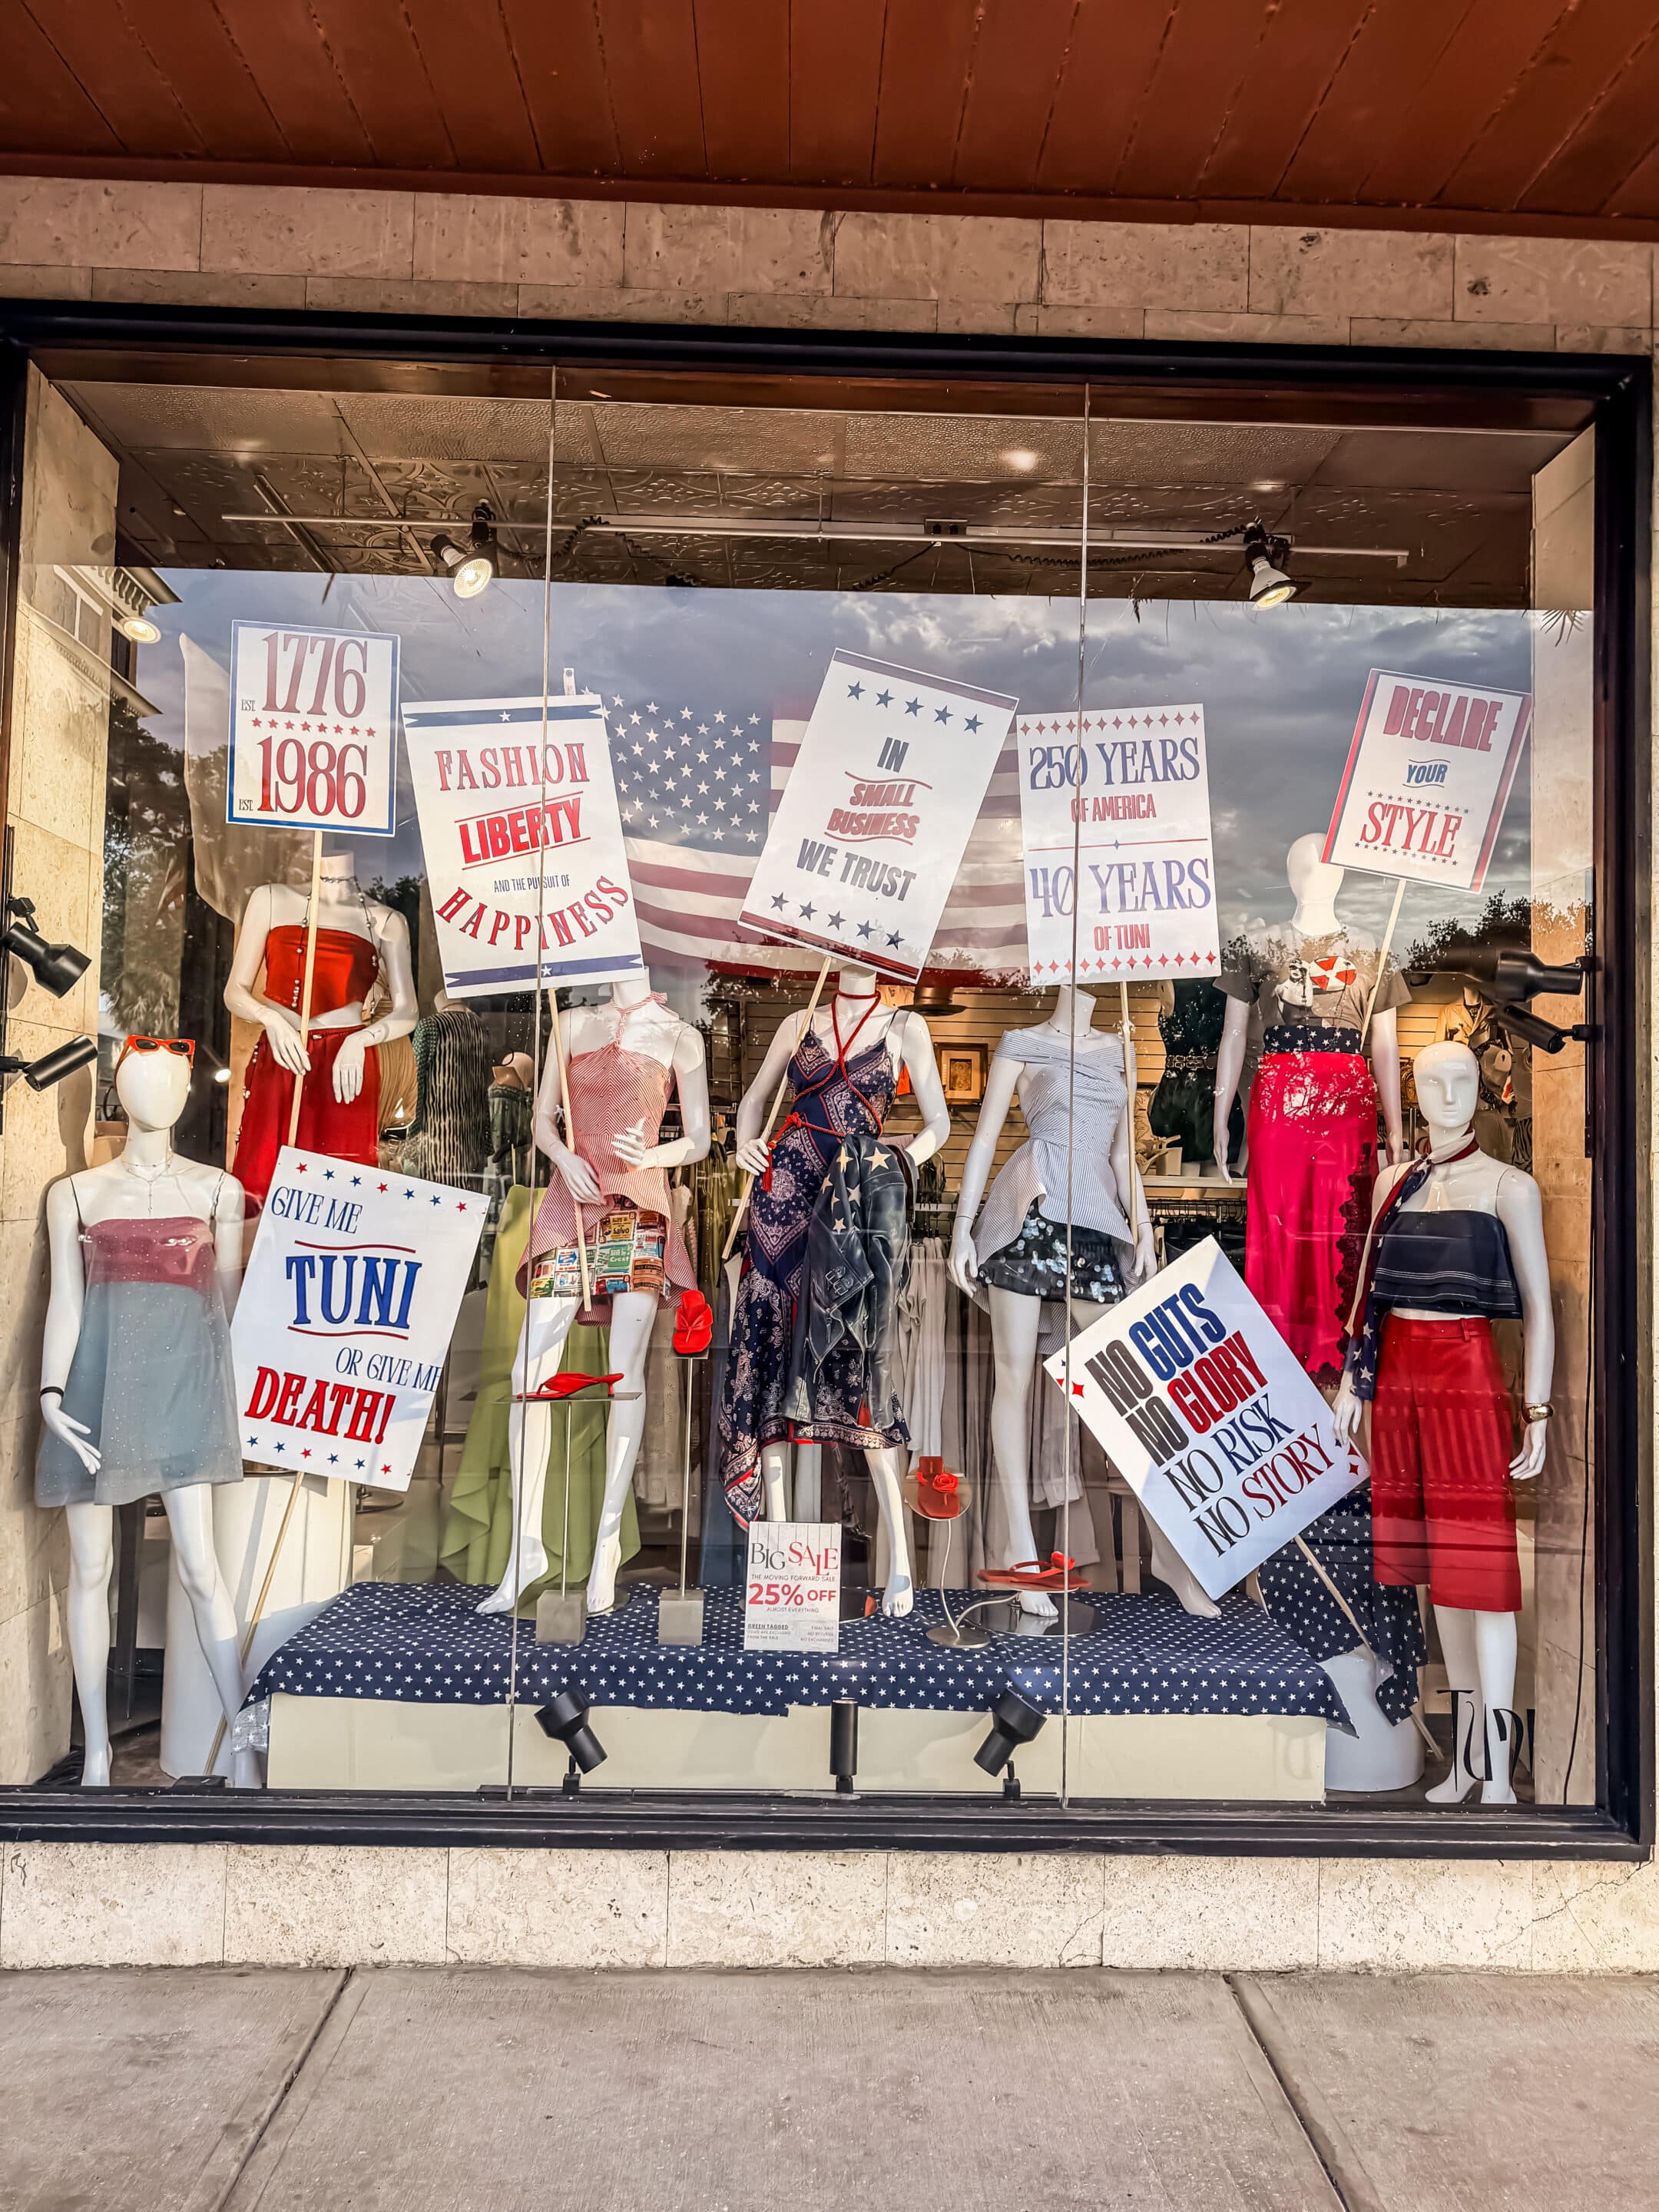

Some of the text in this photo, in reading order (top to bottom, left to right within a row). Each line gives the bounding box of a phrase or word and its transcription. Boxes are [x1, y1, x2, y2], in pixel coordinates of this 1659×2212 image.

[262, 631, 368, 718] 1776
[1382, 685, 1503, 752] DECLARE
[257, 735, 368, 818] 1986
[434, 743, 591, 791] FASHION
[876, 737, 909, 773] IN
[1029, 737, 1200, 790] 250 YEARS
[1406, 763, 1448, 783] YOUR
[826, 808, 920, 839] BUSINESS
[849, 783, 916, 807] SMALL
[1071, 793, 1157, 823] OF AMERICA
[459, 797, 581, 865] LIBERTY
[1359, 801, 1462, 858] STYLE
[494, 879, 510, 892] AND
[511, 878, 526, 891] THE
[561, 874, 570, 887] OF
[796, 839, 917, 902] WE TRUST
[1029, 858, 1211, 918] 40 YEARS
[435, 875, 628, 950] HAPPINESS
[1093, 923, 1151, 952] OF TUNI
[270, 1185, 363, 1234] GIVE ME
[286, 1254, 422, 1330] TUNI
[336, 1347, 363, 1376] OR
[366, 1353, 413, 1386] GIVE
[1084, 1283, 1227, 1417] NO GUTS
[244, 1366, 397, 1445] DEATH!
[1124, 1330, 1269, 1467] NO GLORY
[1163, 1392, 1296, 1513] NO RISK
[1193, 1423, 1335, 1558] NO STORY
[750, 1541, 838, 1575] BIG SALE
[748, 1583, 836, 1606] 25% OFF
